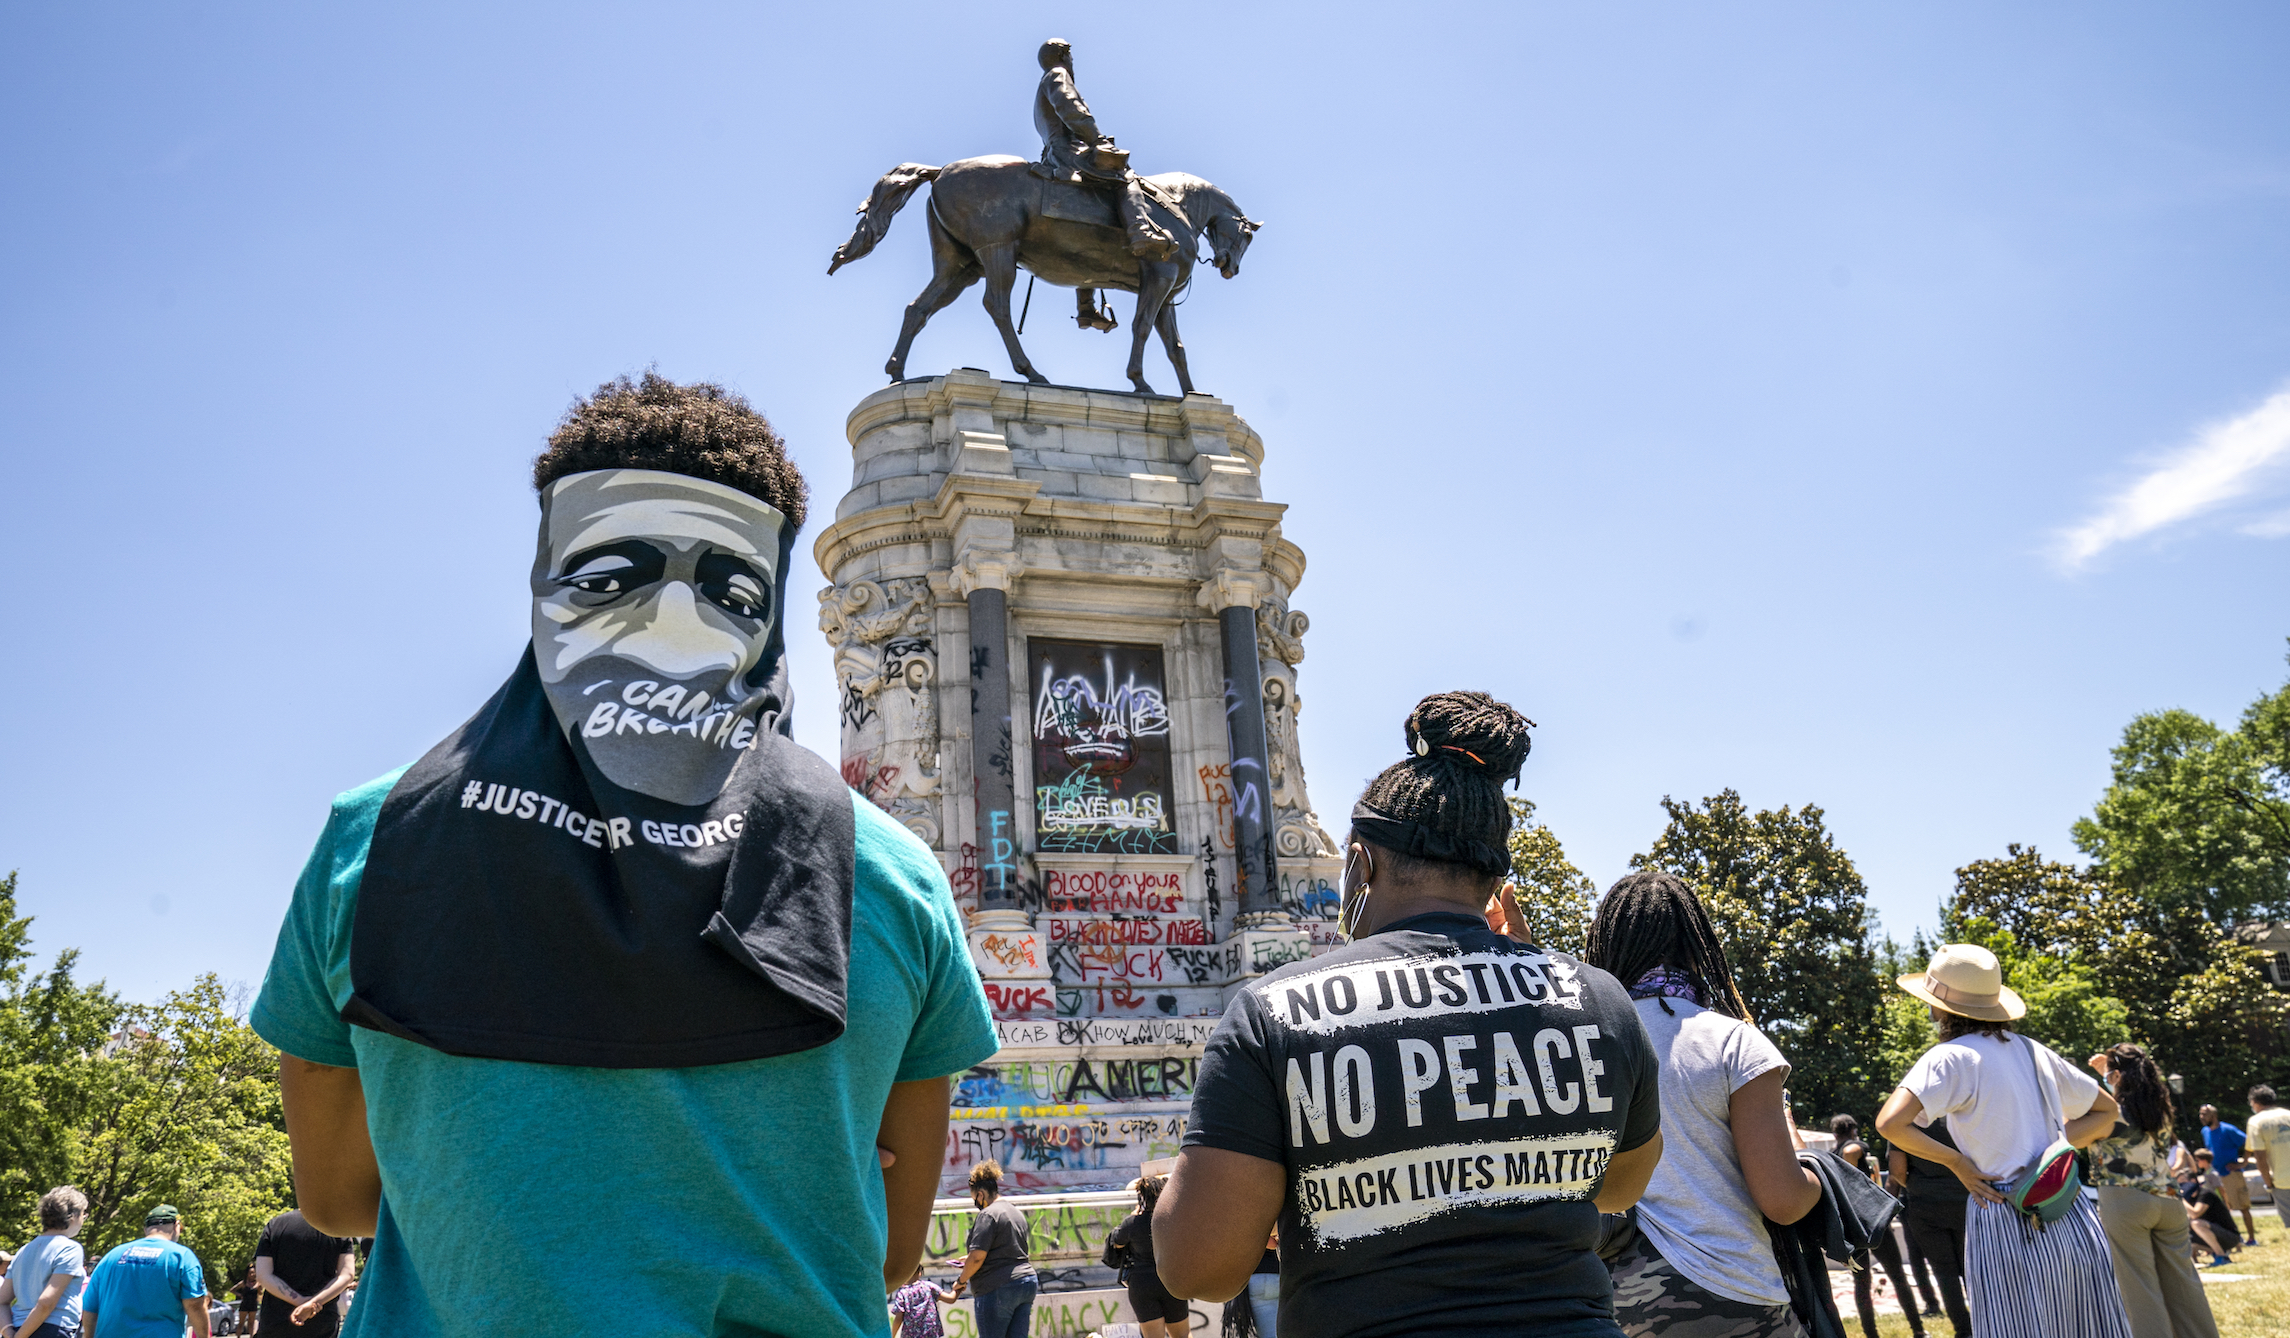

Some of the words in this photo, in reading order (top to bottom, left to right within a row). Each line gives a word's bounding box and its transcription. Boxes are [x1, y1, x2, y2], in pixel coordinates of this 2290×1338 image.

[1199, 763, 1231, 785] FUC
[641, 810, 748, 848] GEORG
[1049, 870, 1107, 897] BLOOD
[1090, 891, 1184, 913] HANDS
[1080, 949, 1164, 981] FUCK
[1167, 947, 1222, 971] FUCK
[1184, 967, 1210, 984] 12
[1097, 976, 1145, 1013] 12
[1286, 974, 1358, 1025] NO
[1376, 962, 1576, 1012] JUSTICE
[998, 1022, 1048, 1043] ACAB
[1095, 1024, 1130, 1041] HOW
[1138, 1022, 1186, 1041] MUCH
[1064, 1057, 1199, 1103] AMERI
[1286, 1044, 1378, 1148] NO
[1397, 1024, 1614, 1128] PEACE
[1304, 1167, 1400, 1213] BLACK
[1408, 1155, 1495, 1201] LIVES
[1504, 1146, 1608, 1187] MATTER
